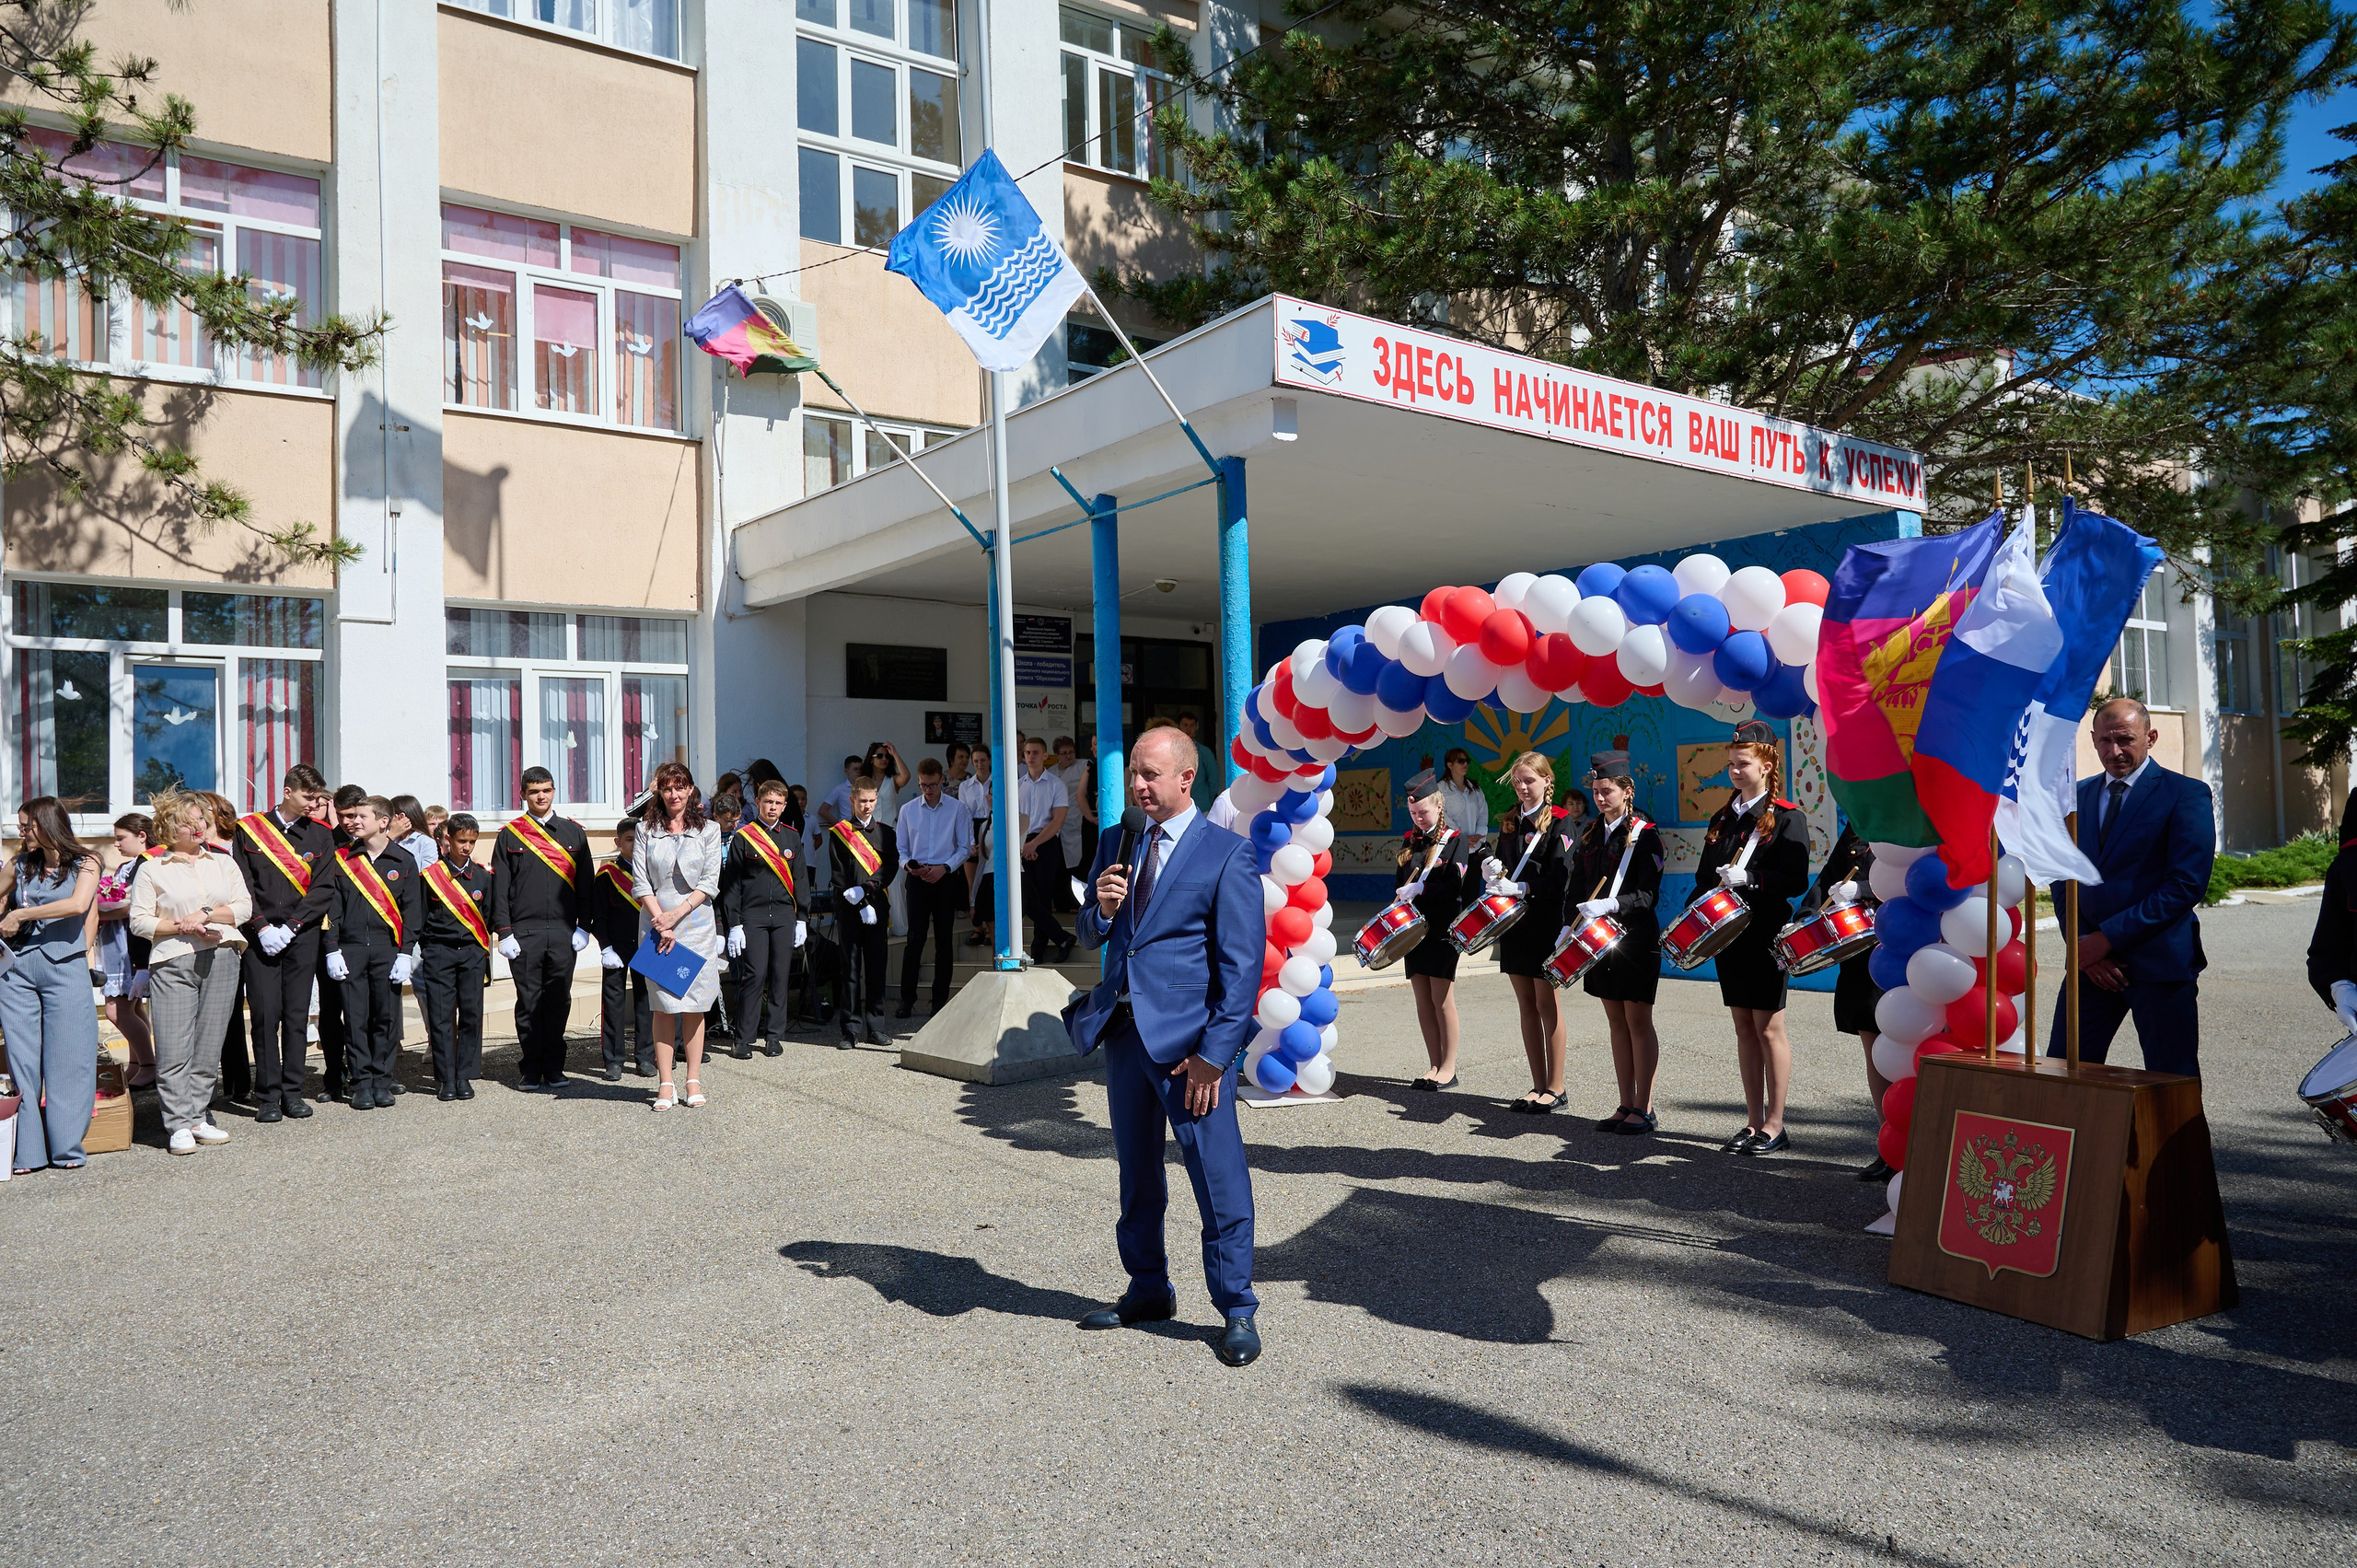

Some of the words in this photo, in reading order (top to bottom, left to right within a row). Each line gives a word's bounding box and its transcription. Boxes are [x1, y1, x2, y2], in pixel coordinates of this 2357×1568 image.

[1372, 336, 1475, 405] ЗДЕСЬ
[1493, 366, 1673, 448] НАЧИНАЕТСЯ
[1689, 411, 1740, 462] ВАШ
[1750, 424, 1805, 475] ПУТЬ
[1818, 441, 1831, 482] К
[1843, 447, 1923, 499] УСПЕХУ!
[1036, 660, 1066, 668] победитель
